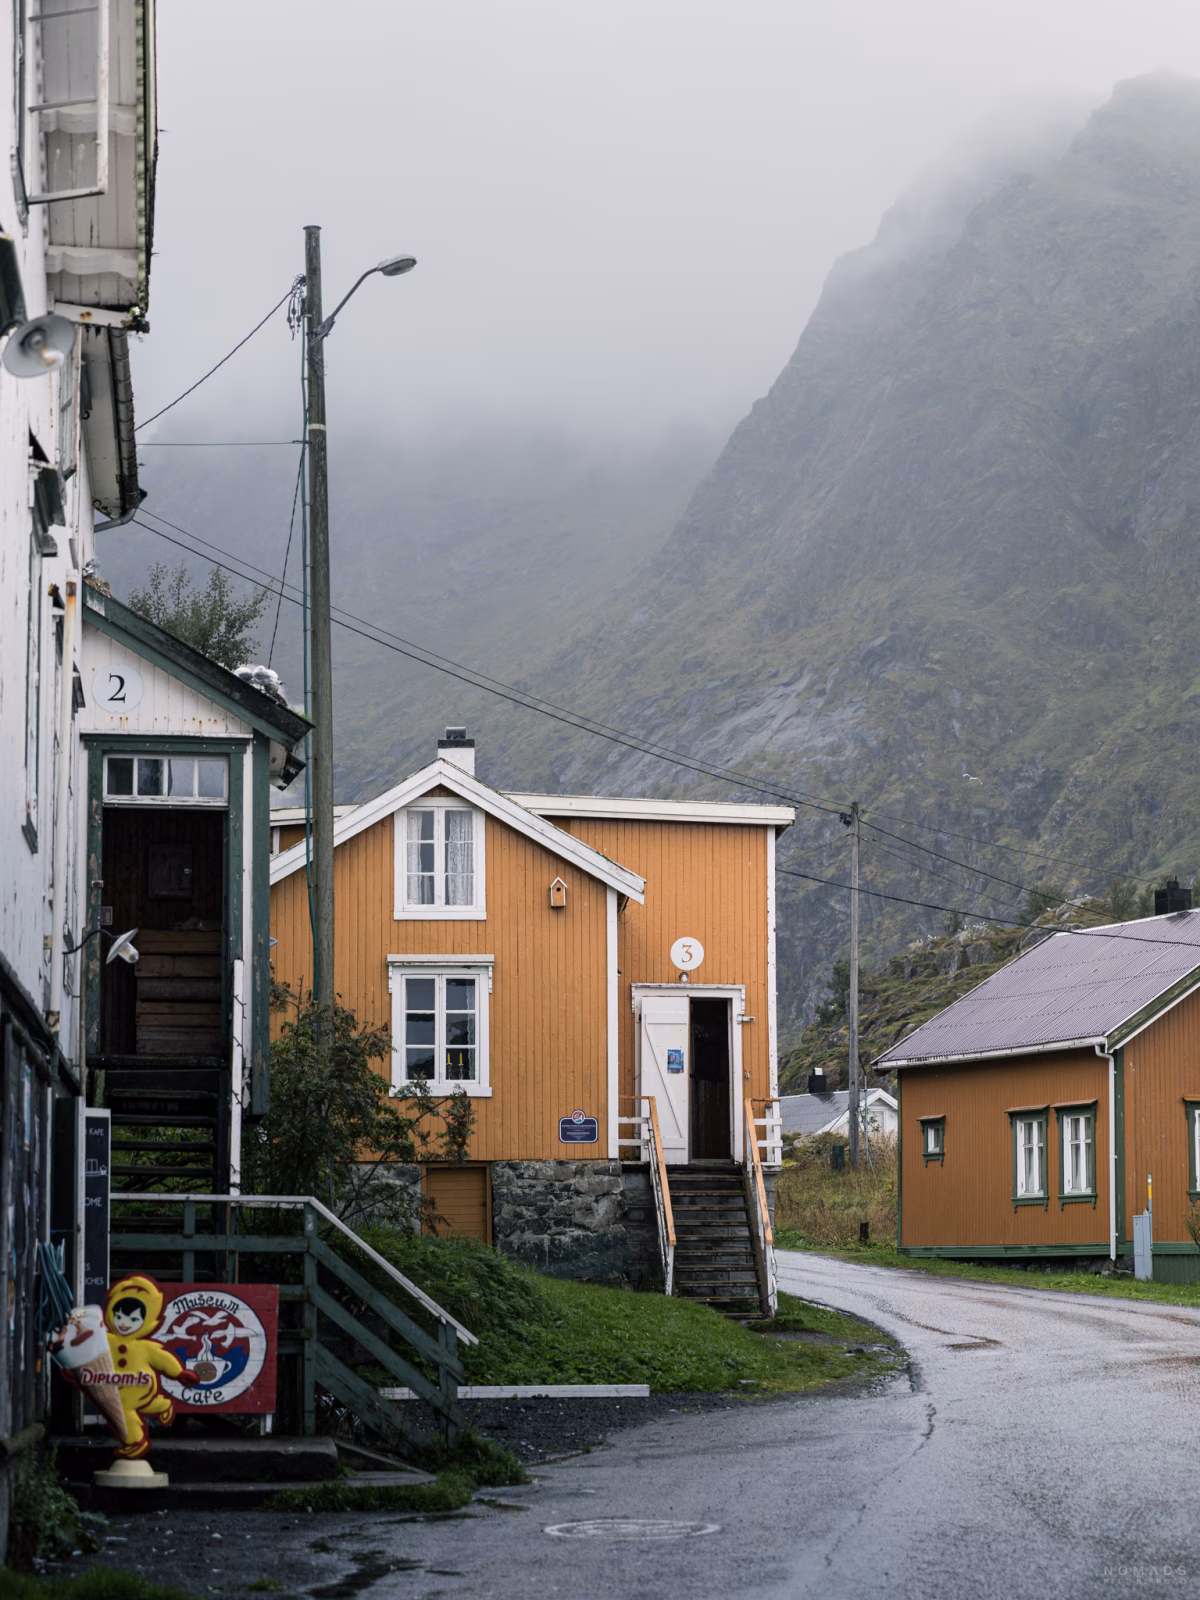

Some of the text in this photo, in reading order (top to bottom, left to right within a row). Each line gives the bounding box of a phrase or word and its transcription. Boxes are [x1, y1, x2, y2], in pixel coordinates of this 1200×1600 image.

[107, 672, 127, 704] 2
[681, 943, 694, 964] 3
[85, 1196, 103, 1207] OME
[85, 1276, 104, 1285] ICHES
[172, 1293, 240, 1314] Museum
[181, 1386, 225, 1404] Cafe
